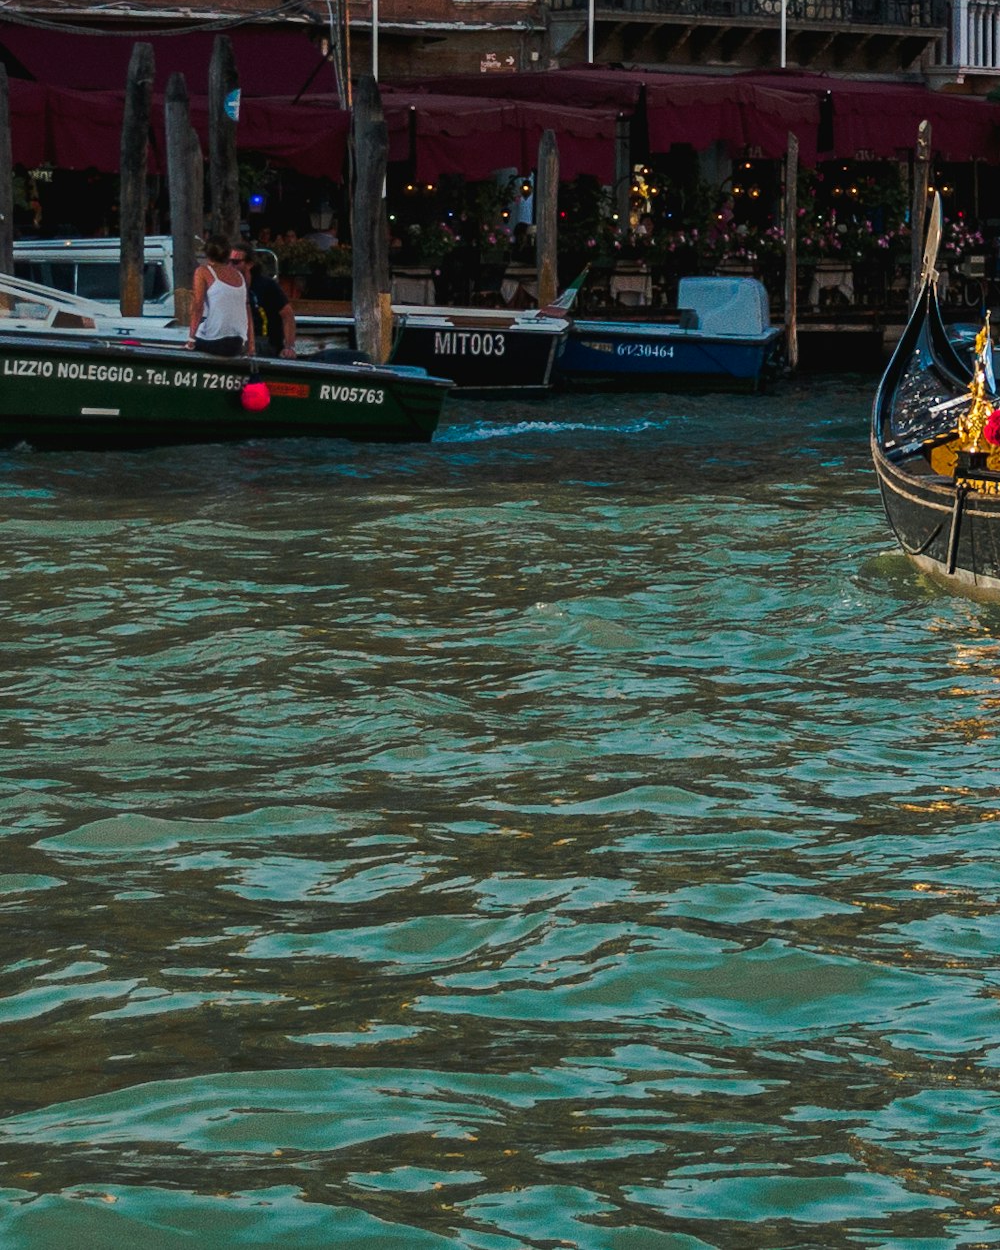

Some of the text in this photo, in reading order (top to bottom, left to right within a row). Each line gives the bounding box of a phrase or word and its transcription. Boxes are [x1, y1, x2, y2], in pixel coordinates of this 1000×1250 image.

[434, 332, 505, 356] MIT003
[4, 359, 53, 377] LIZZIO
[57, 362, 134, 383] NOLEGGIO
[146, 369, 170, 386] Tel.
[174, 371, 198, 387] 041
[319, 384, 385, 405] RV05763
